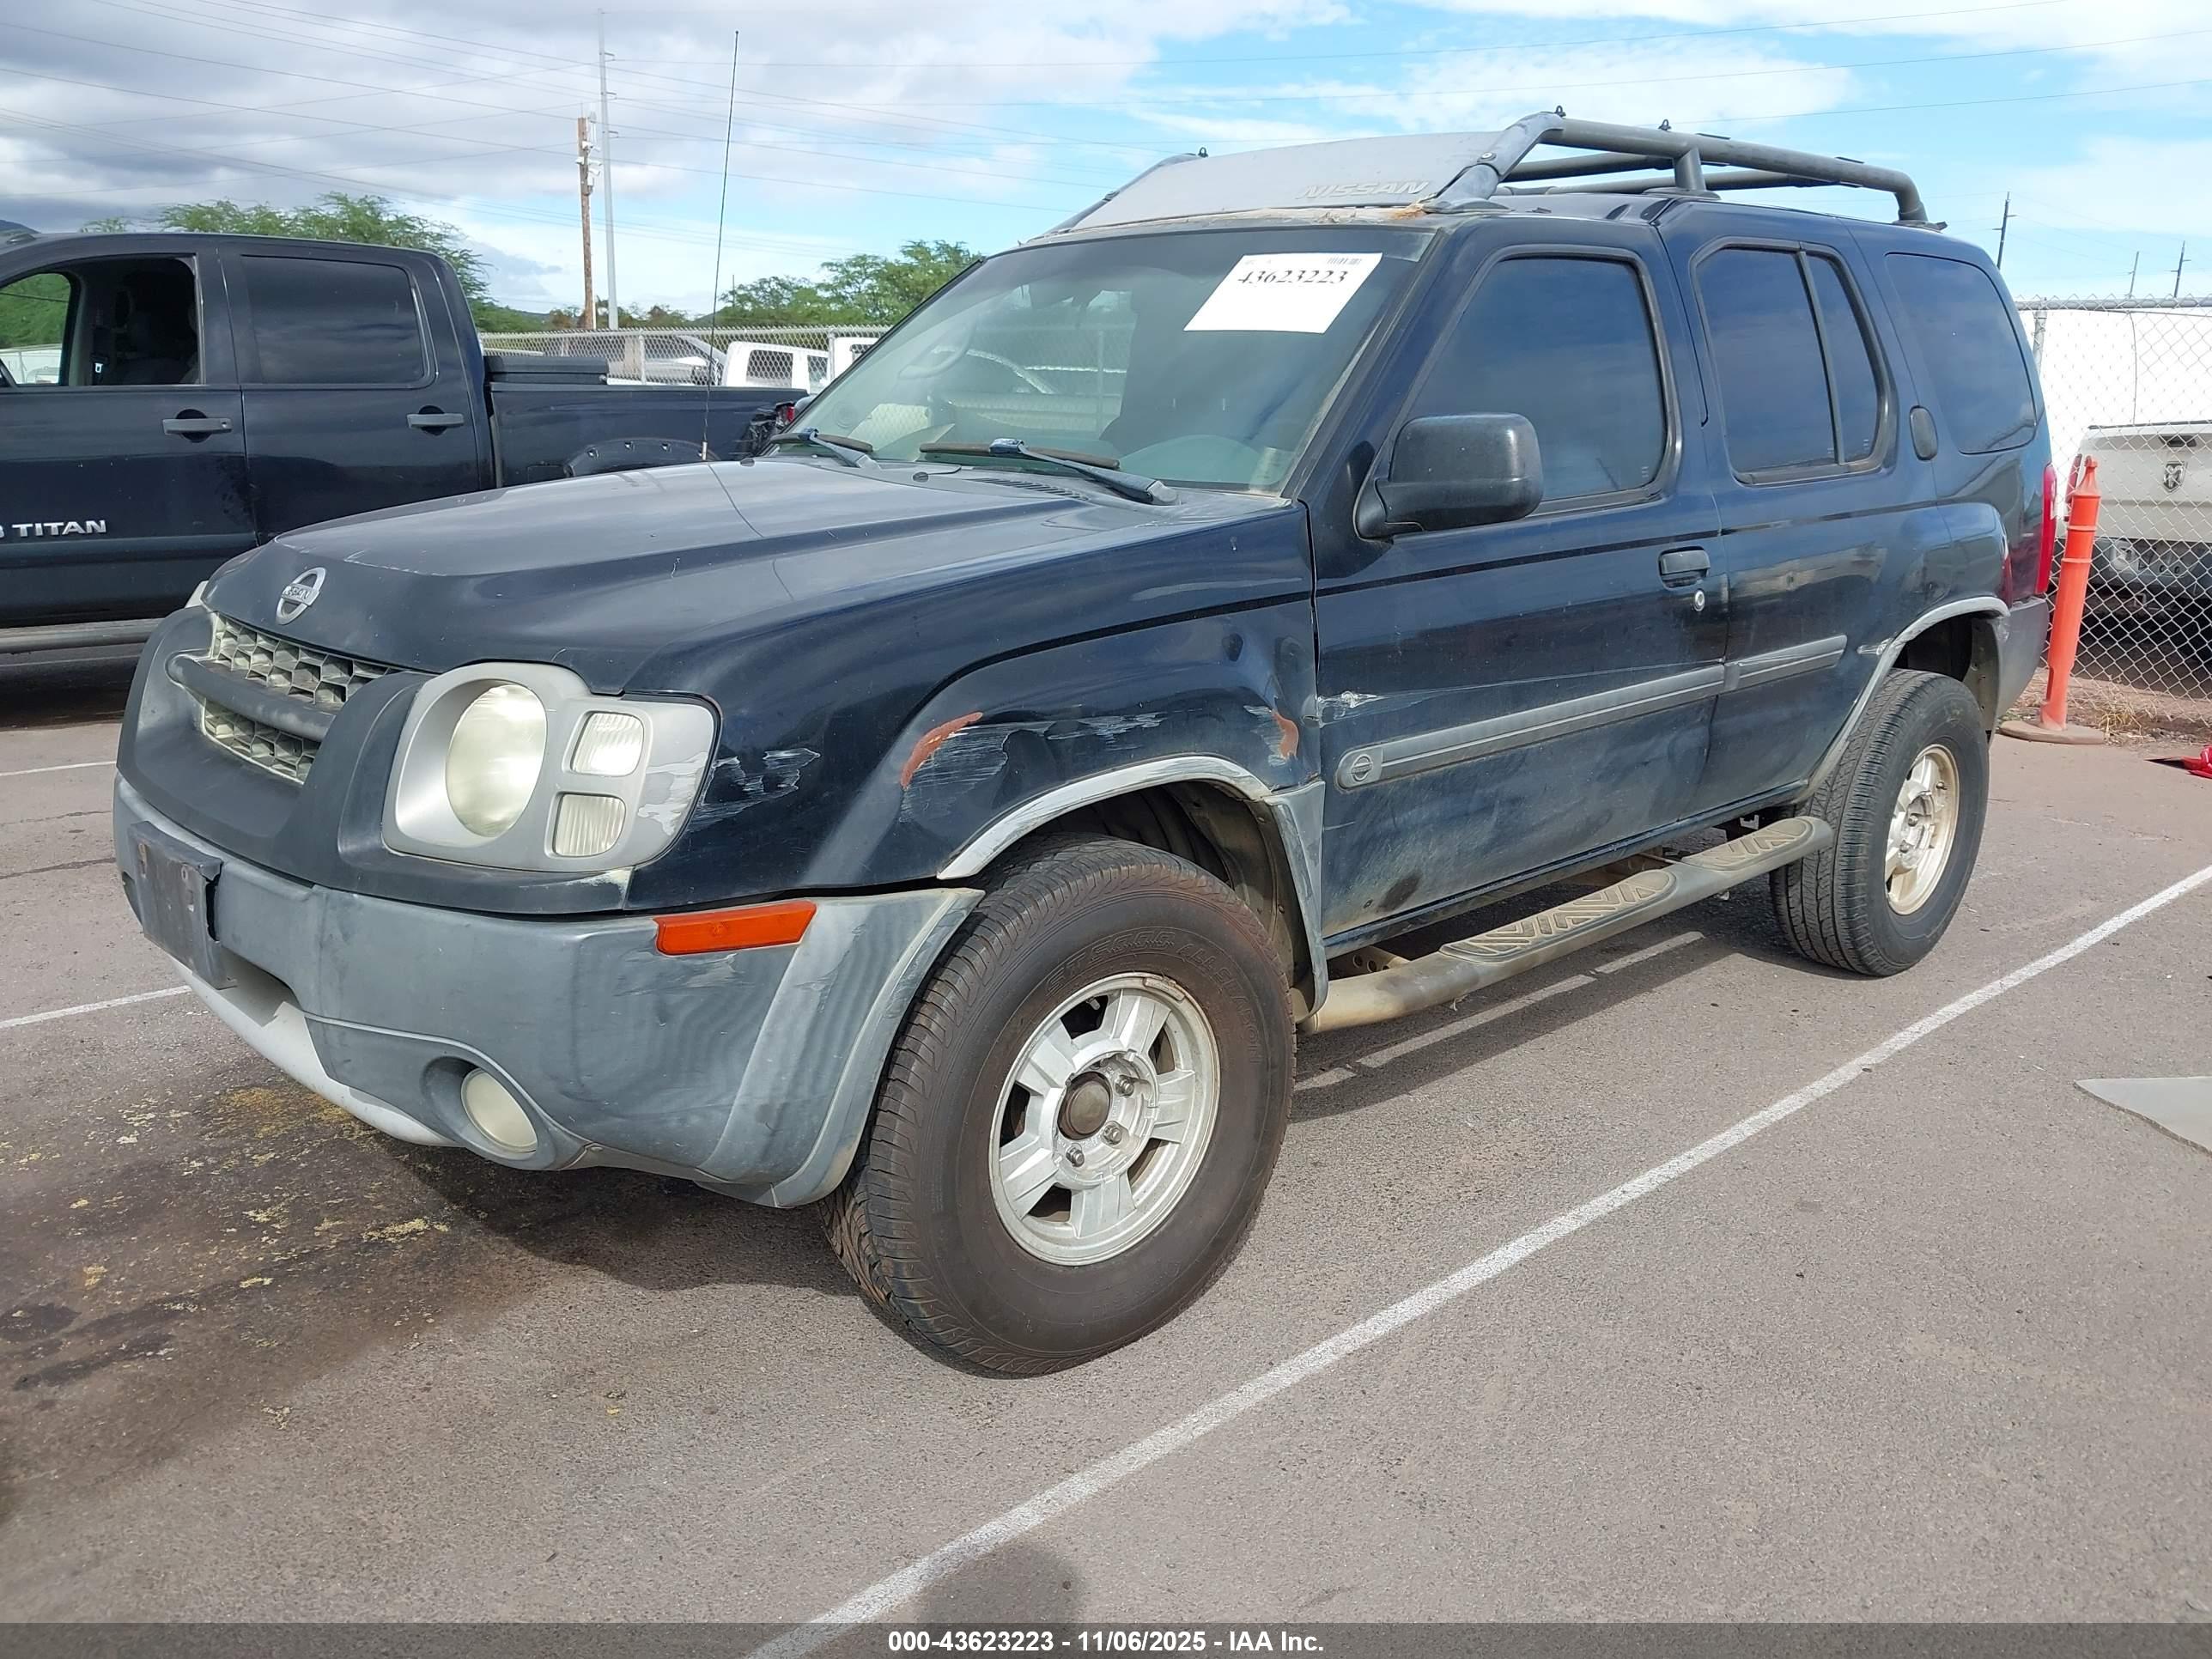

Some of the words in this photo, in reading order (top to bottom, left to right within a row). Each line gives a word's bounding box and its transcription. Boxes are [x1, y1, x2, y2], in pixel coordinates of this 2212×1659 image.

[1295, 180, 1431, 199] NISSAN
[1237, 270, 1349, 284] 43623223
[11, 520, 107, 538] TITAN
